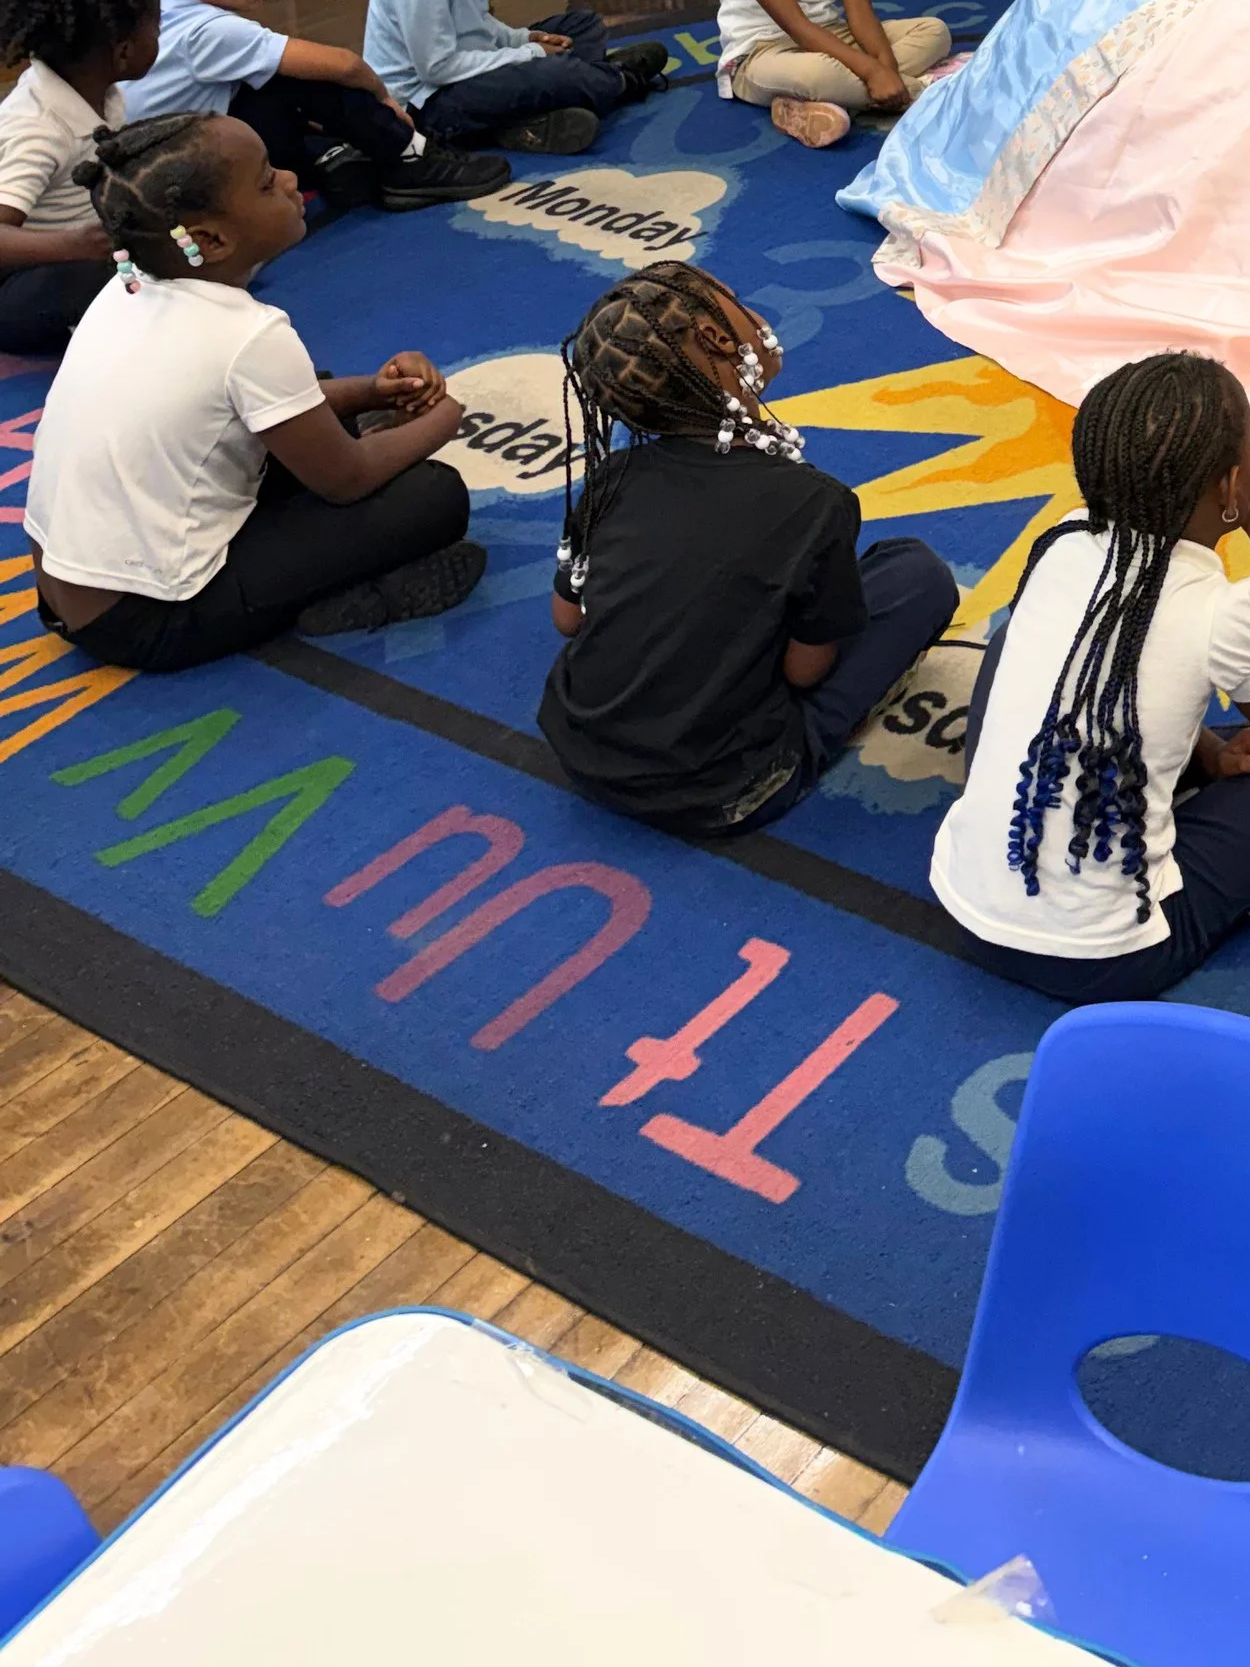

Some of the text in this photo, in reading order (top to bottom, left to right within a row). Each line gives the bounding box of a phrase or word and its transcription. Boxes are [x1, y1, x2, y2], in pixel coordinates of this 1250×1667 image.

[499, 180, 707, 251] Monday
[49, 708, 900, 1204] Tt Uu Vv
